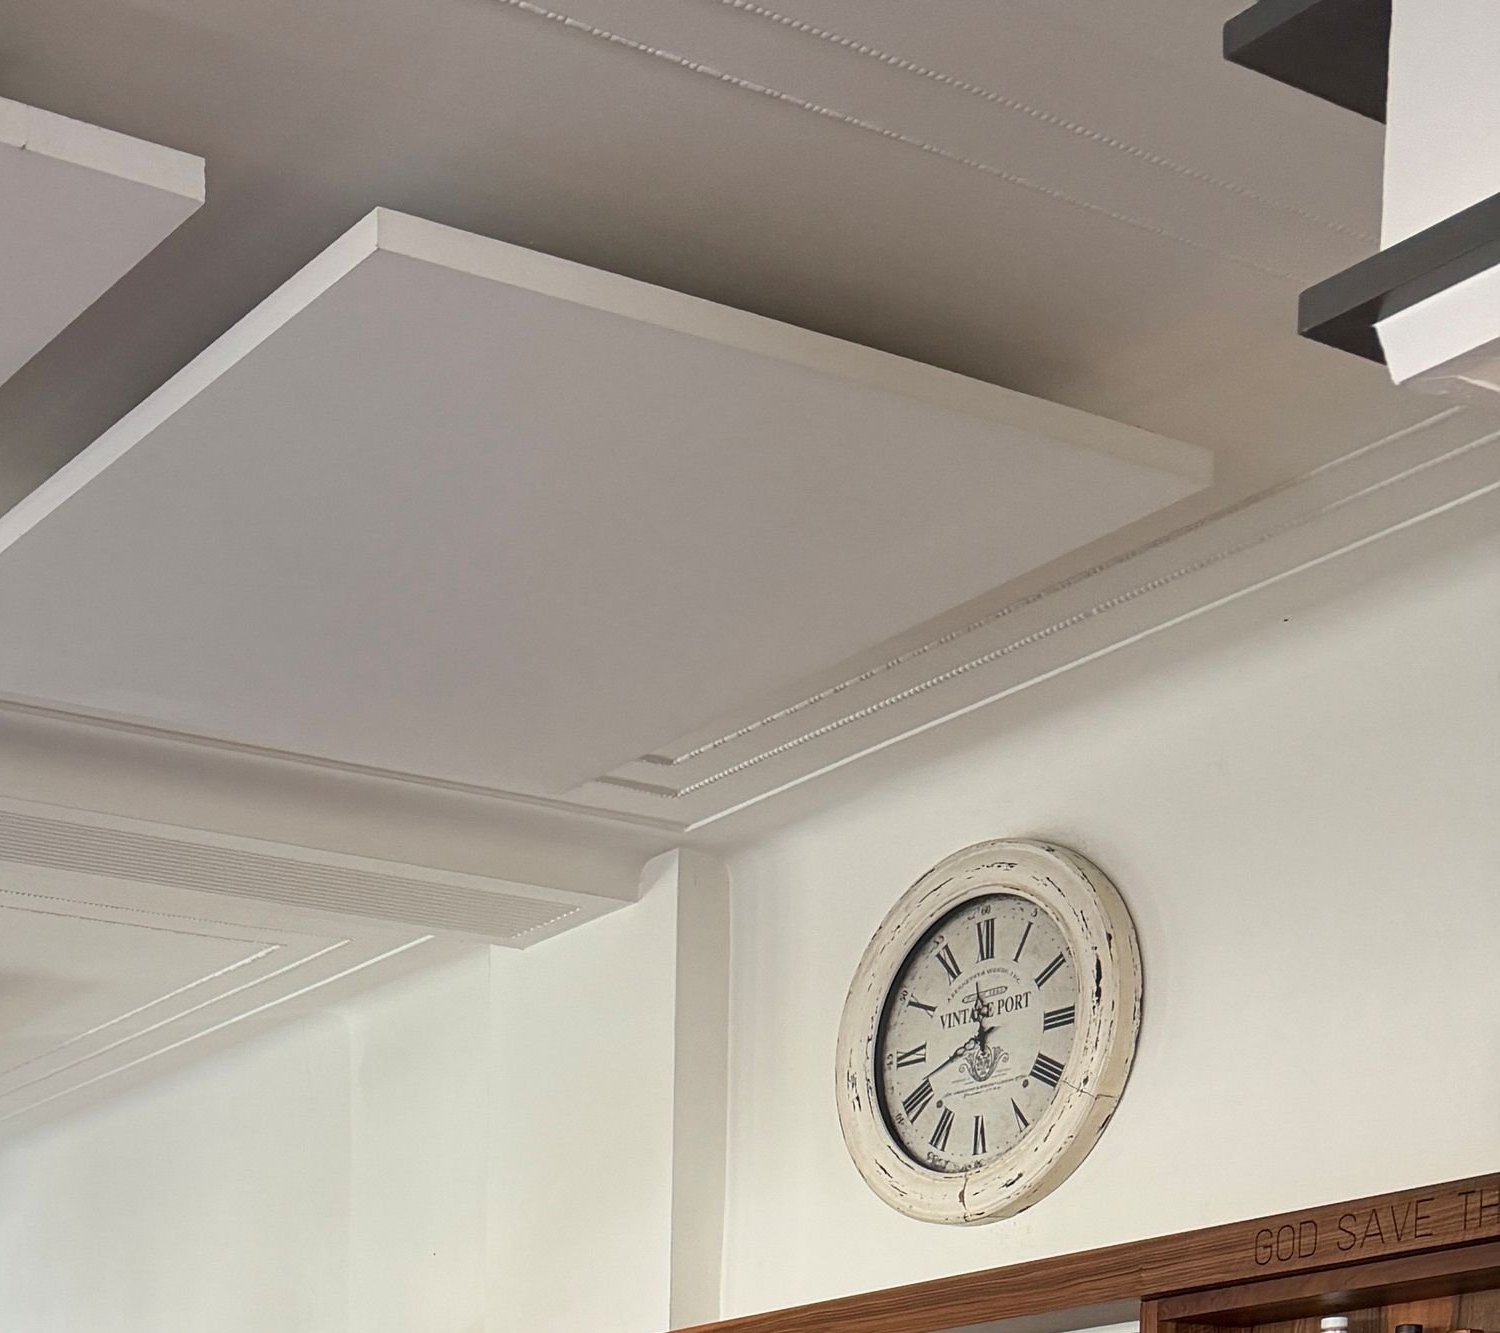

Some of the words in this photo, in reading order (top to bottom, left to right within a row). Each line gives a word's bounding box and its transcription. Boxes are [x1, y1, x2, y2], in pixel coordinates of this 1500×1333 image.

[940, 1001, 994, 1029] VINTAE
[997, 991, 1032, 1016] PORT
[1254, 1220, 1318, 1266] GOD
[1336, 1197, 1436, 1251] SAVE
[1457, 1189, 1500, 1231] TH
